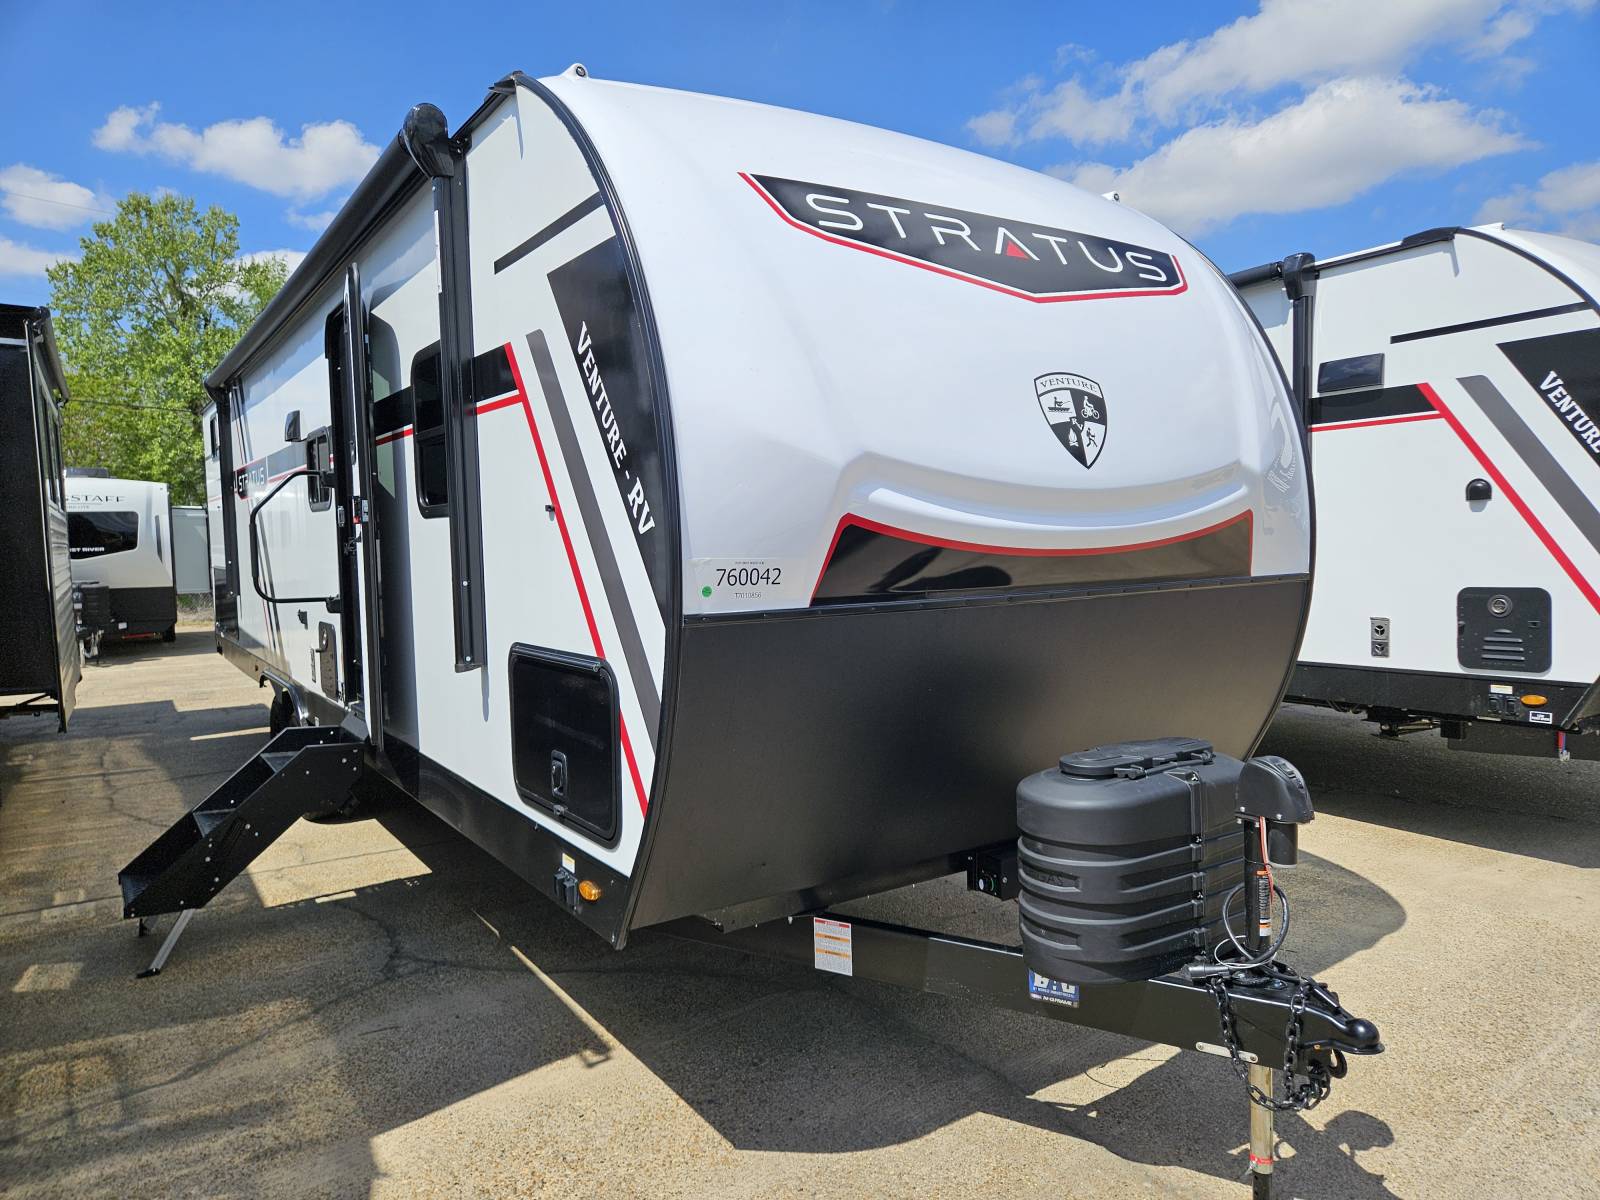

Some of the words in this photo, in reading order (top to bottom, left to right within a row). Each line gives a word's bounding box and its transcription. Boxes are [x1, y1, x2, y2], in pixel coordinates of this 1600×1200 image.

[806, 193, 1167, 282] STRATUS
[1040, 377, 1098, 393] VENTURE
[577, 321, 627, 469] VENTURE
[628, 477, 655, 535] RV
[716, 567, 782, 587] 760042
